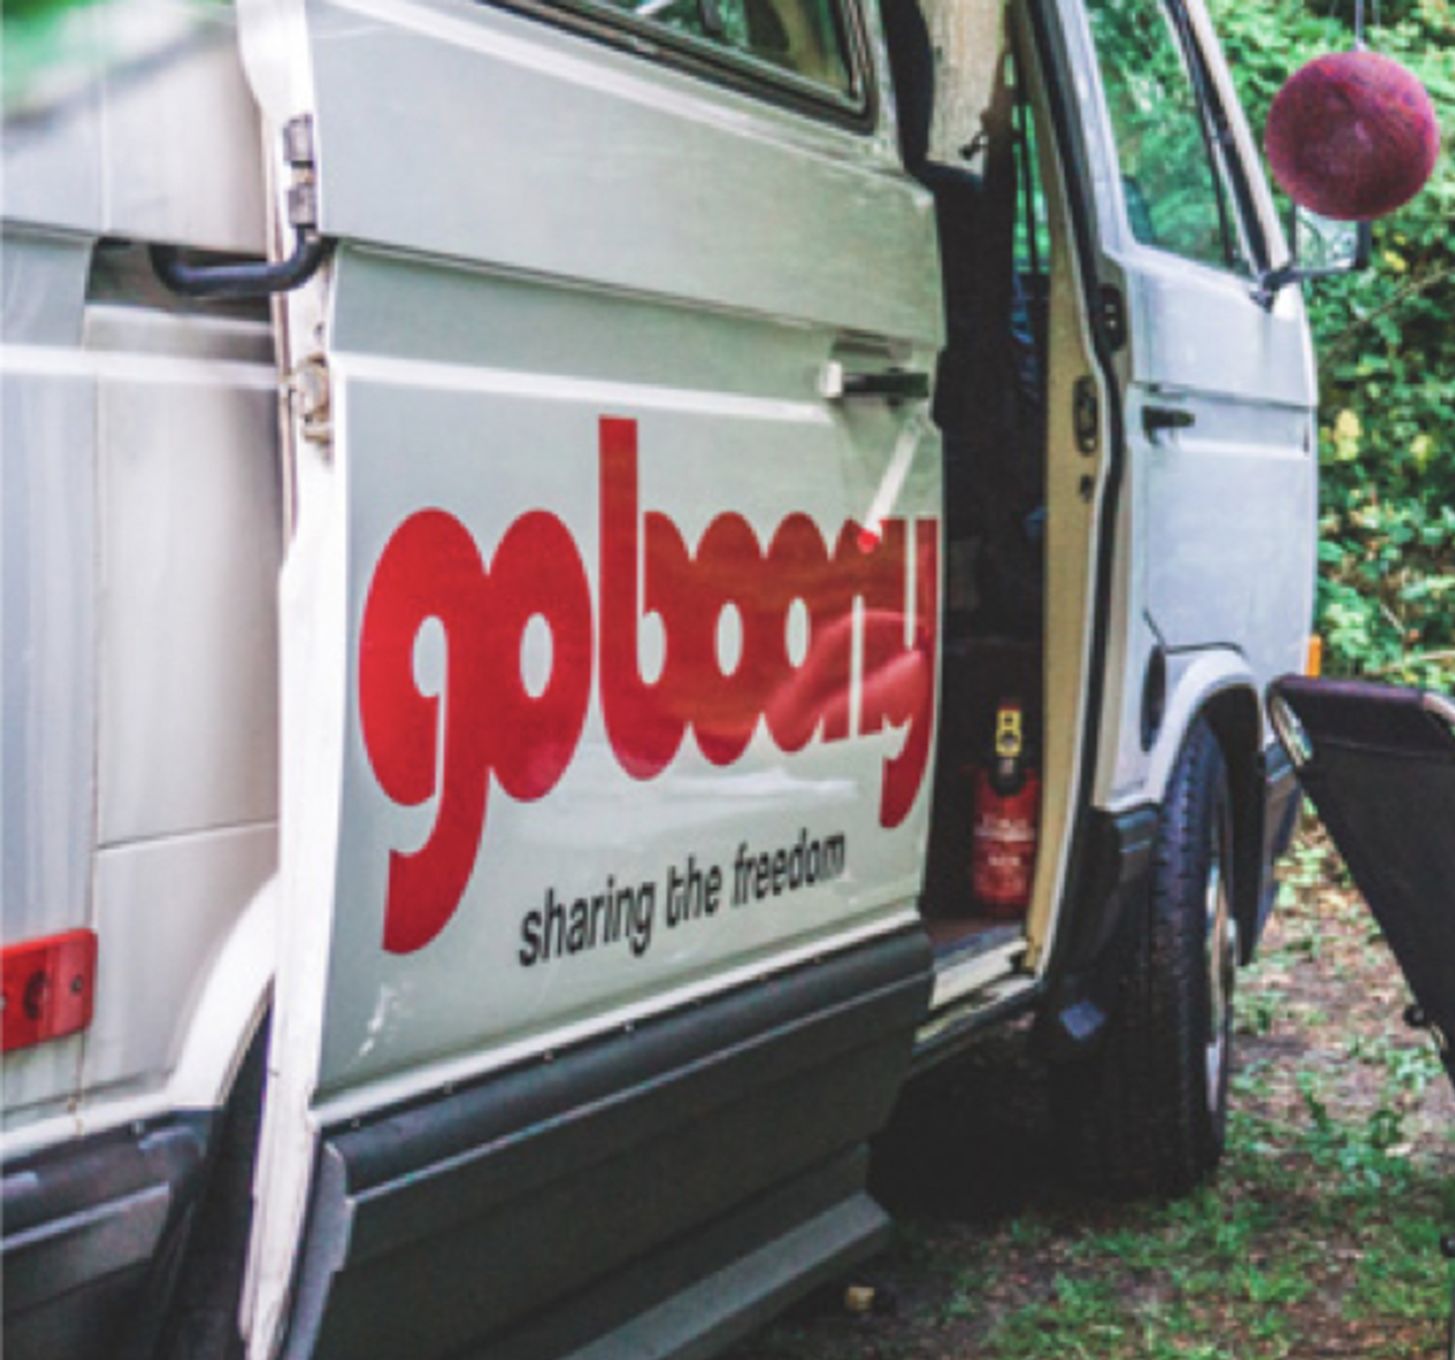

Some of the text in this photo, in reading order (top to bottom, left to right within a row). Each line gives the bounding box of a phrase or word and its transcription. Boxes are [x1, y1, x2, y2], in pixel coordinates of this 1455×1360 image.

[359, 415, 938, 954] goboony
[518, 827, 846, 967] sharing the freedom
